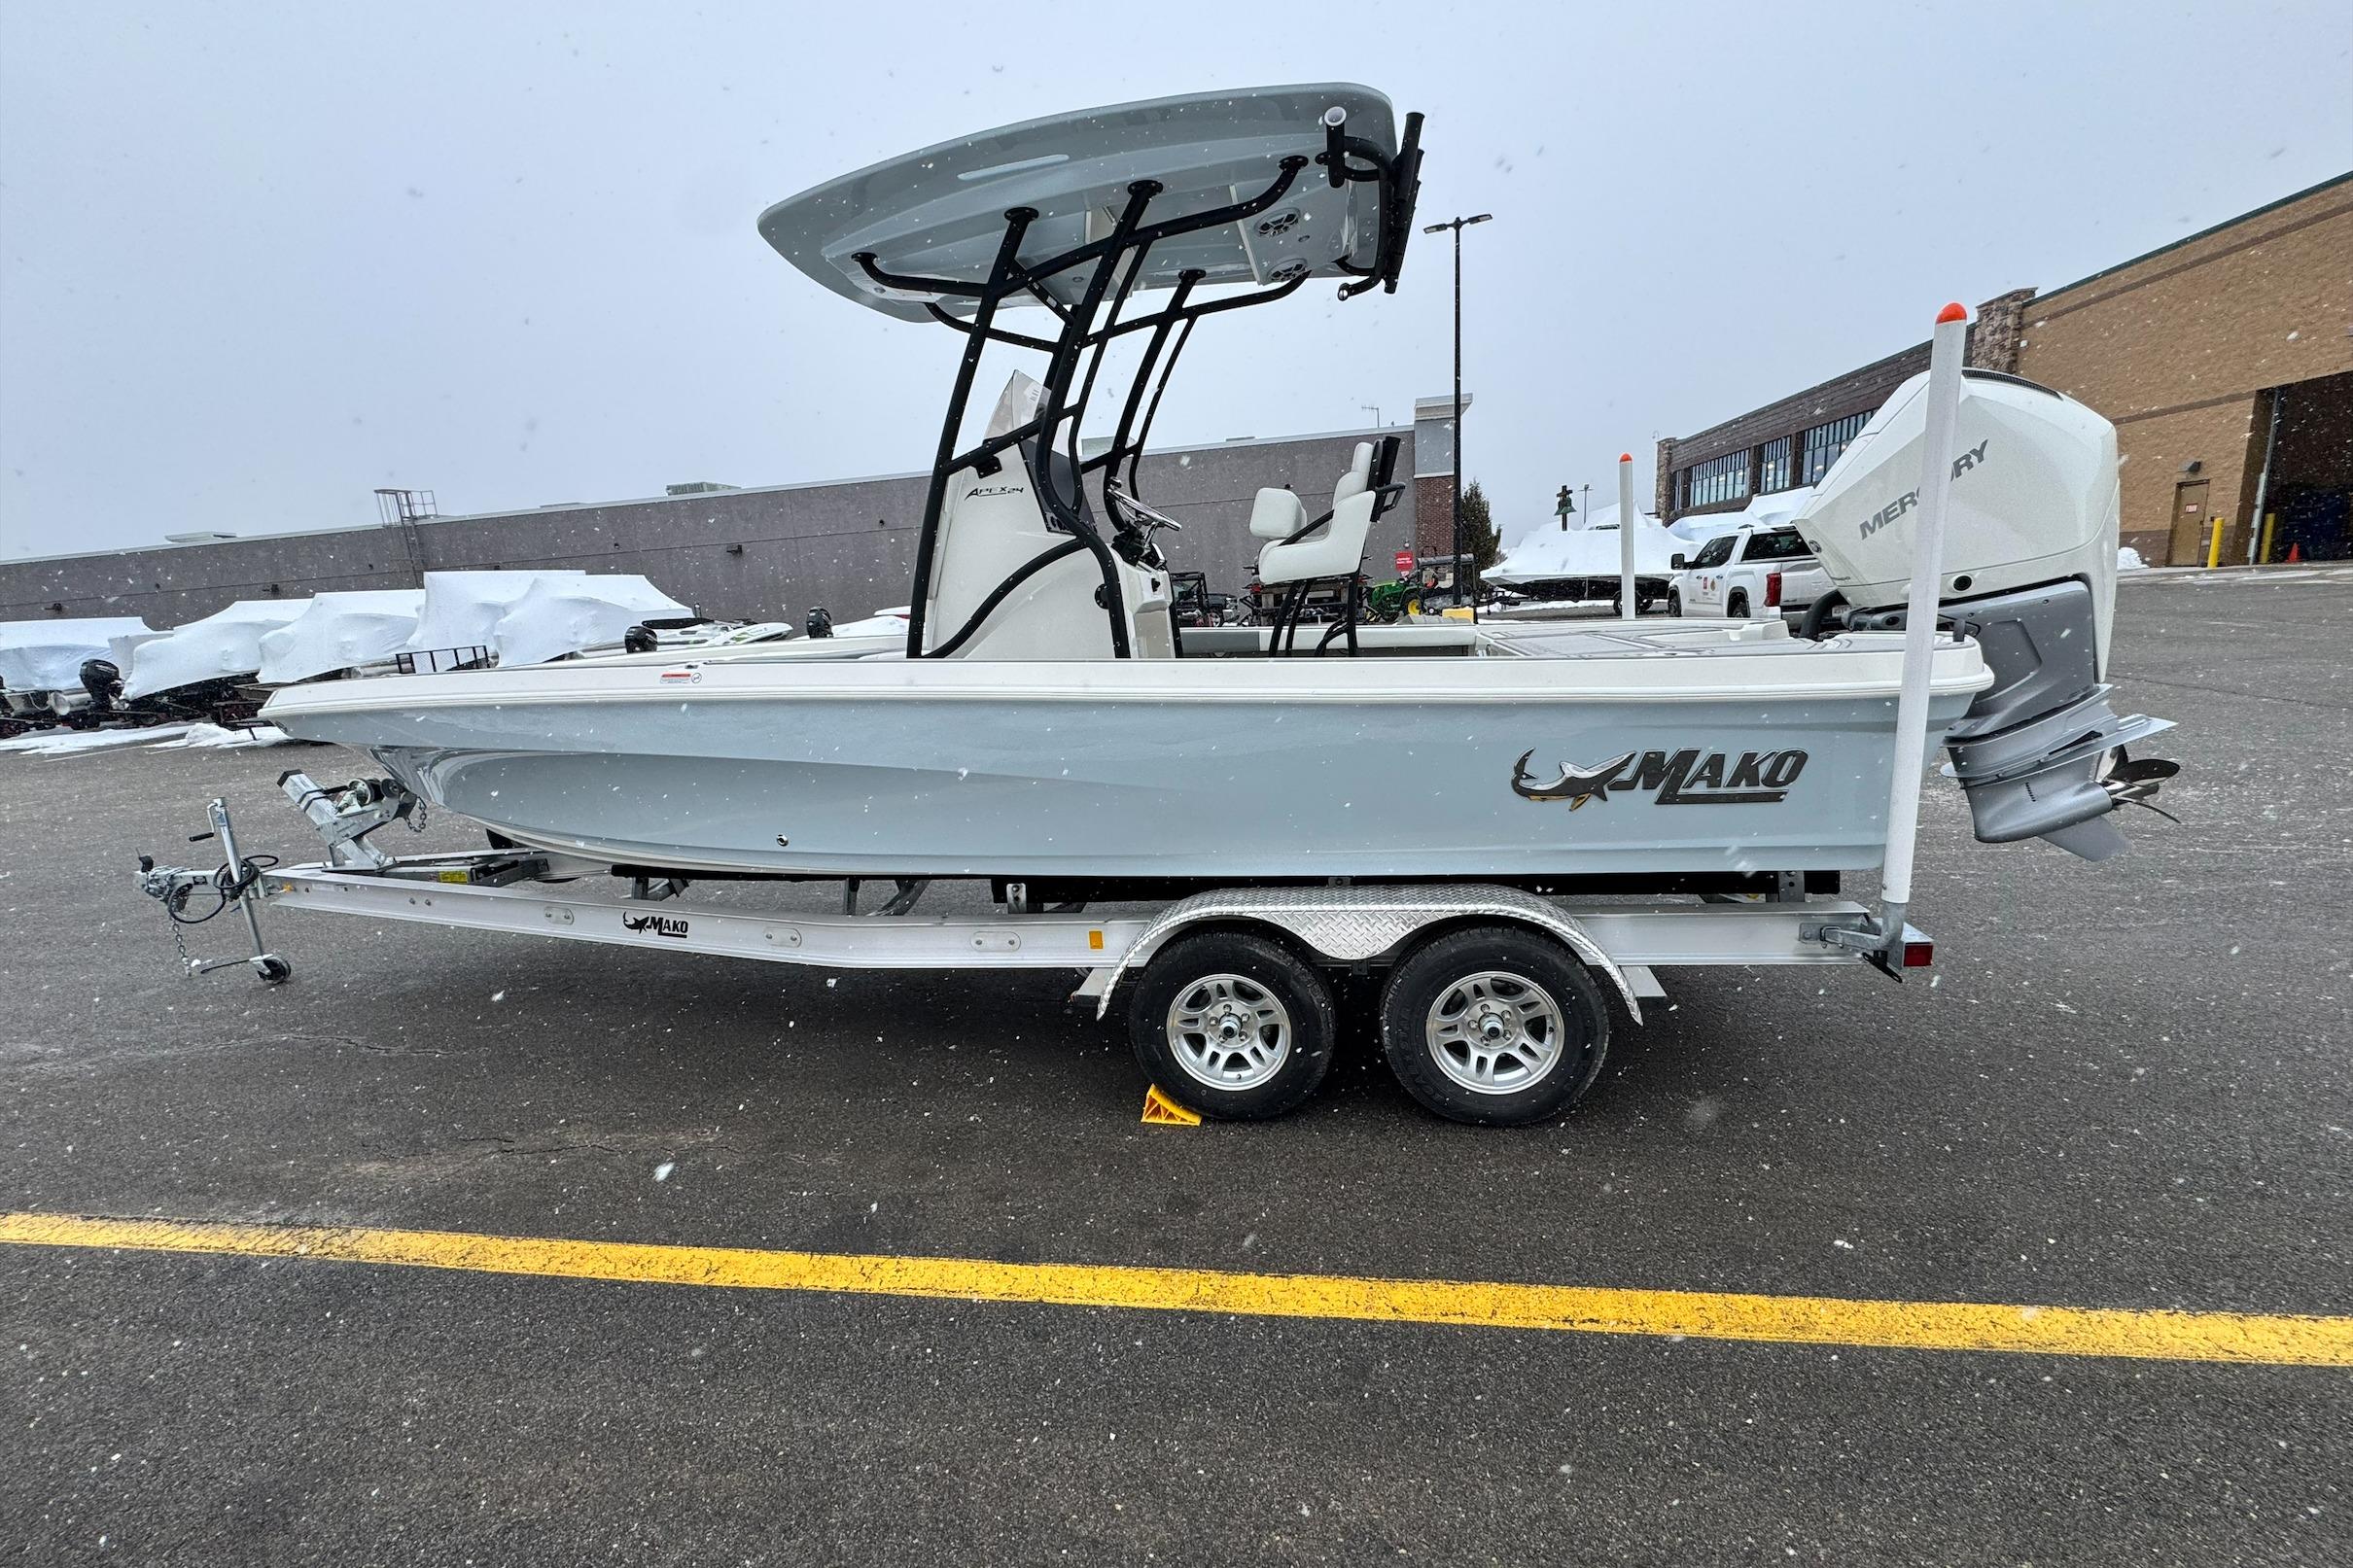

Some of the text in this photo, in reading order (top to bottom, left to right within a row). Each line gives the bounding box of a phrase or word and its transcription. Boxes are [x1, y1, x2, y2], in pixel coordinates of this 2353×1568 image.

[1859, 438, 1988, 540] MERRY
[1607, 748, 1809, 805] MAKO
[646, 916, 688, 938] MAKO
